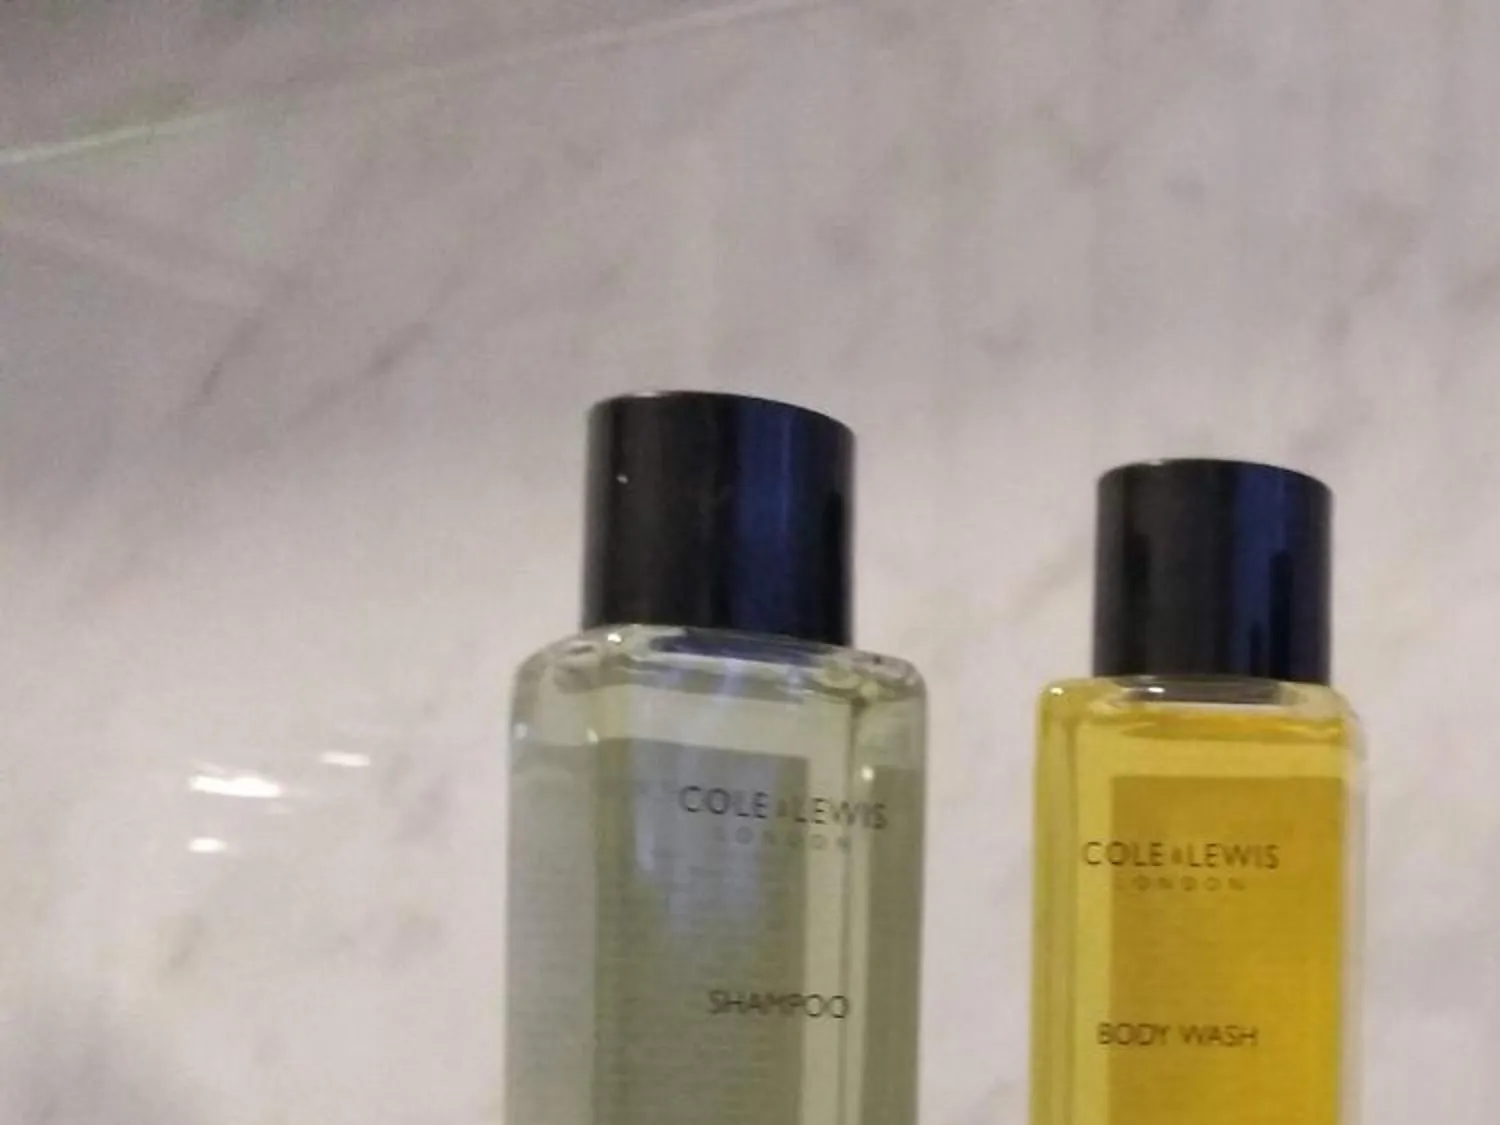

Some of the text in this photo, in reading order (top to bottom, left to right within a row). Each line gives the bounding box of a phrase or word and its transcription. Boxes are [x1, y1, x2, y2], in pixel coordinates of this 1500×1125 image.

[679, 785, 768, 819] COLE
[791, 795, 888, 830] LEWIS
[1081, 840, 1165, 868] COLE
[1186, 842, 1281, 870] LEWIS
[709, 988, 850, 1020] SHAMPOO
[1096, 1022, 1261, 1048] BODY WASH
